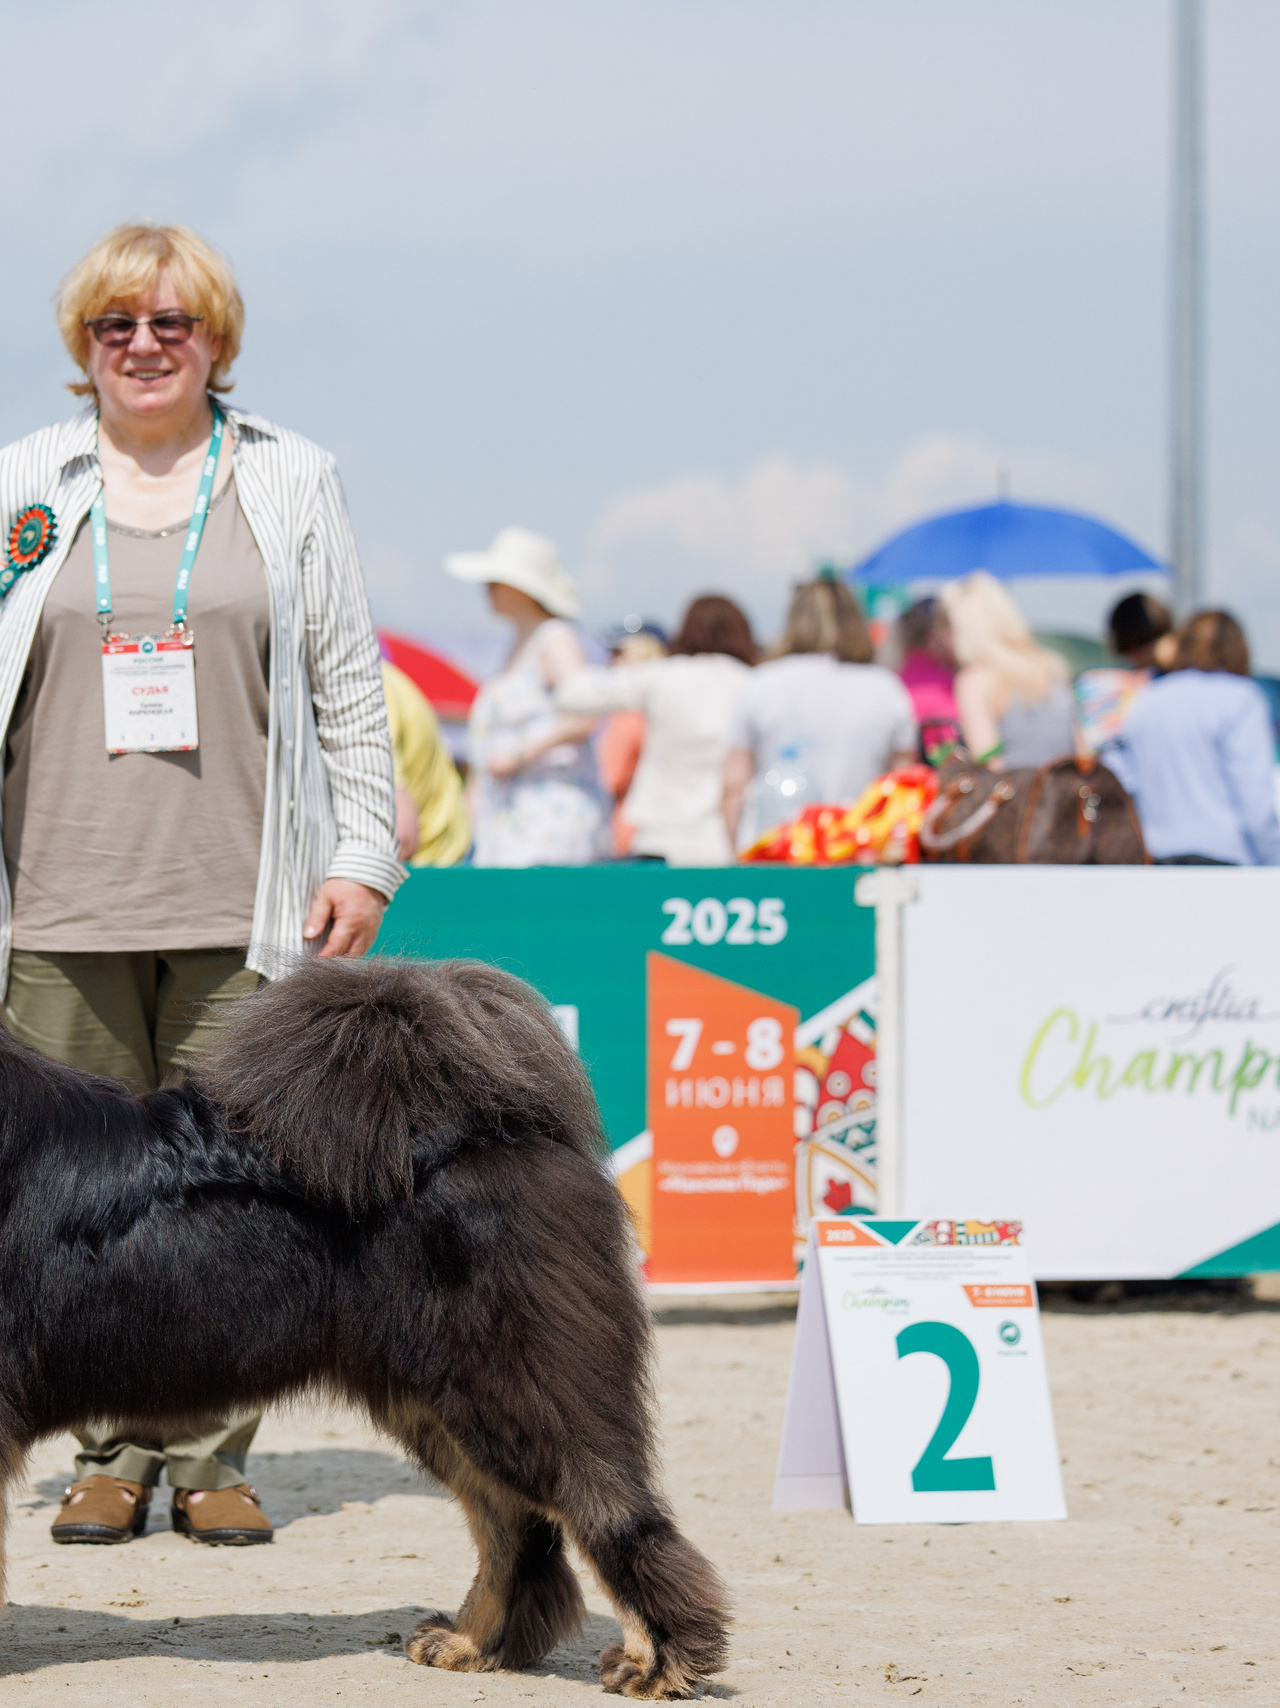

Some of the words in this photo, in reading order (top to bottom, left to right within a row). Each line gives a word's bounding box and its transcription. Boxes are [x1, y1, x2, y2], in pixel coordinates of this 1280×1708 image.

[131, 685, 169, 697] СУДЬЯ
[661, 897, 788, 946] 2025
[665, 1018, 704, 1072] 7
[744, 1016, 784, 1071] 8
[665, 1076, 785, 1109] ИЮНЯ
[825, 1229, 856, 1242] 2025
[896, 1321, 996, 1492] 2
